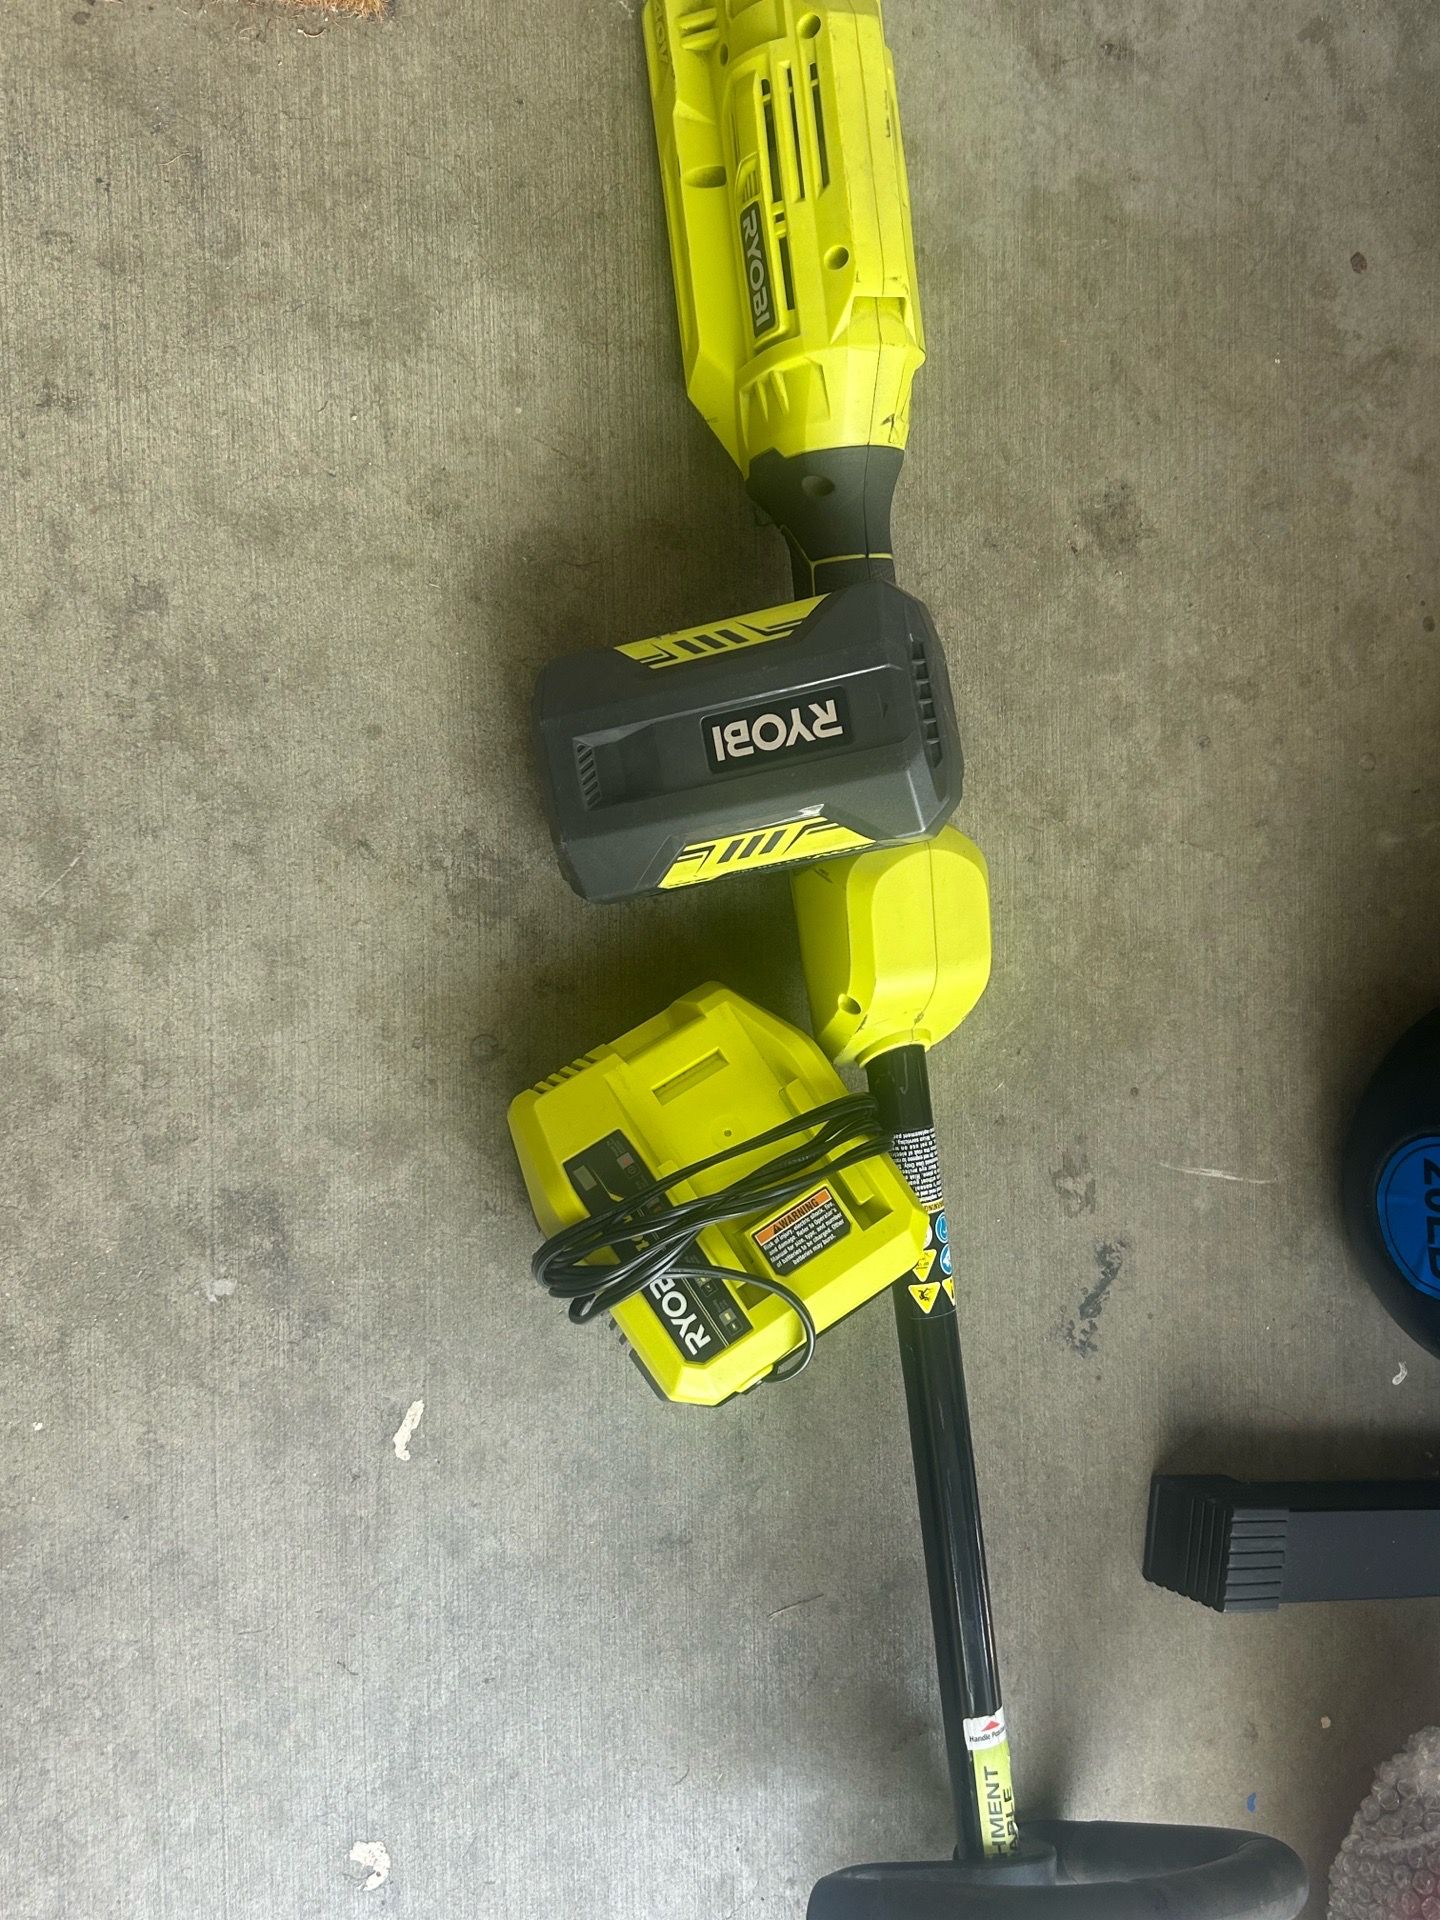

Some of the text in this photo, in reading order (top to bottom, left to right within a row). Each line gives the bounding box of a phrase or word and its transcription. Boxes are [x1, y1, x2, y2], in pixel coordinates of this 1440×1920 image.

[743, 209, 770, 327] RYOBI
[712, 699, 844, 762] RYOBI
[778, 1198, 819, 1227] WARNING
[816, 1224, 824, 1232] and
[825, 1212, 841, 1226] number
[764, 1242, 773, 1251] Risk
[769, 1247, 777, 1255] and
[782, 1248, 801, 1264] batteries
[813, 1228, 831, 1243] charged.
[832, 1219, 843, 1230] Other
[793, 1234, 835, 1265] batteries may burst.
[970, 1733, 990, 1743] Handle
